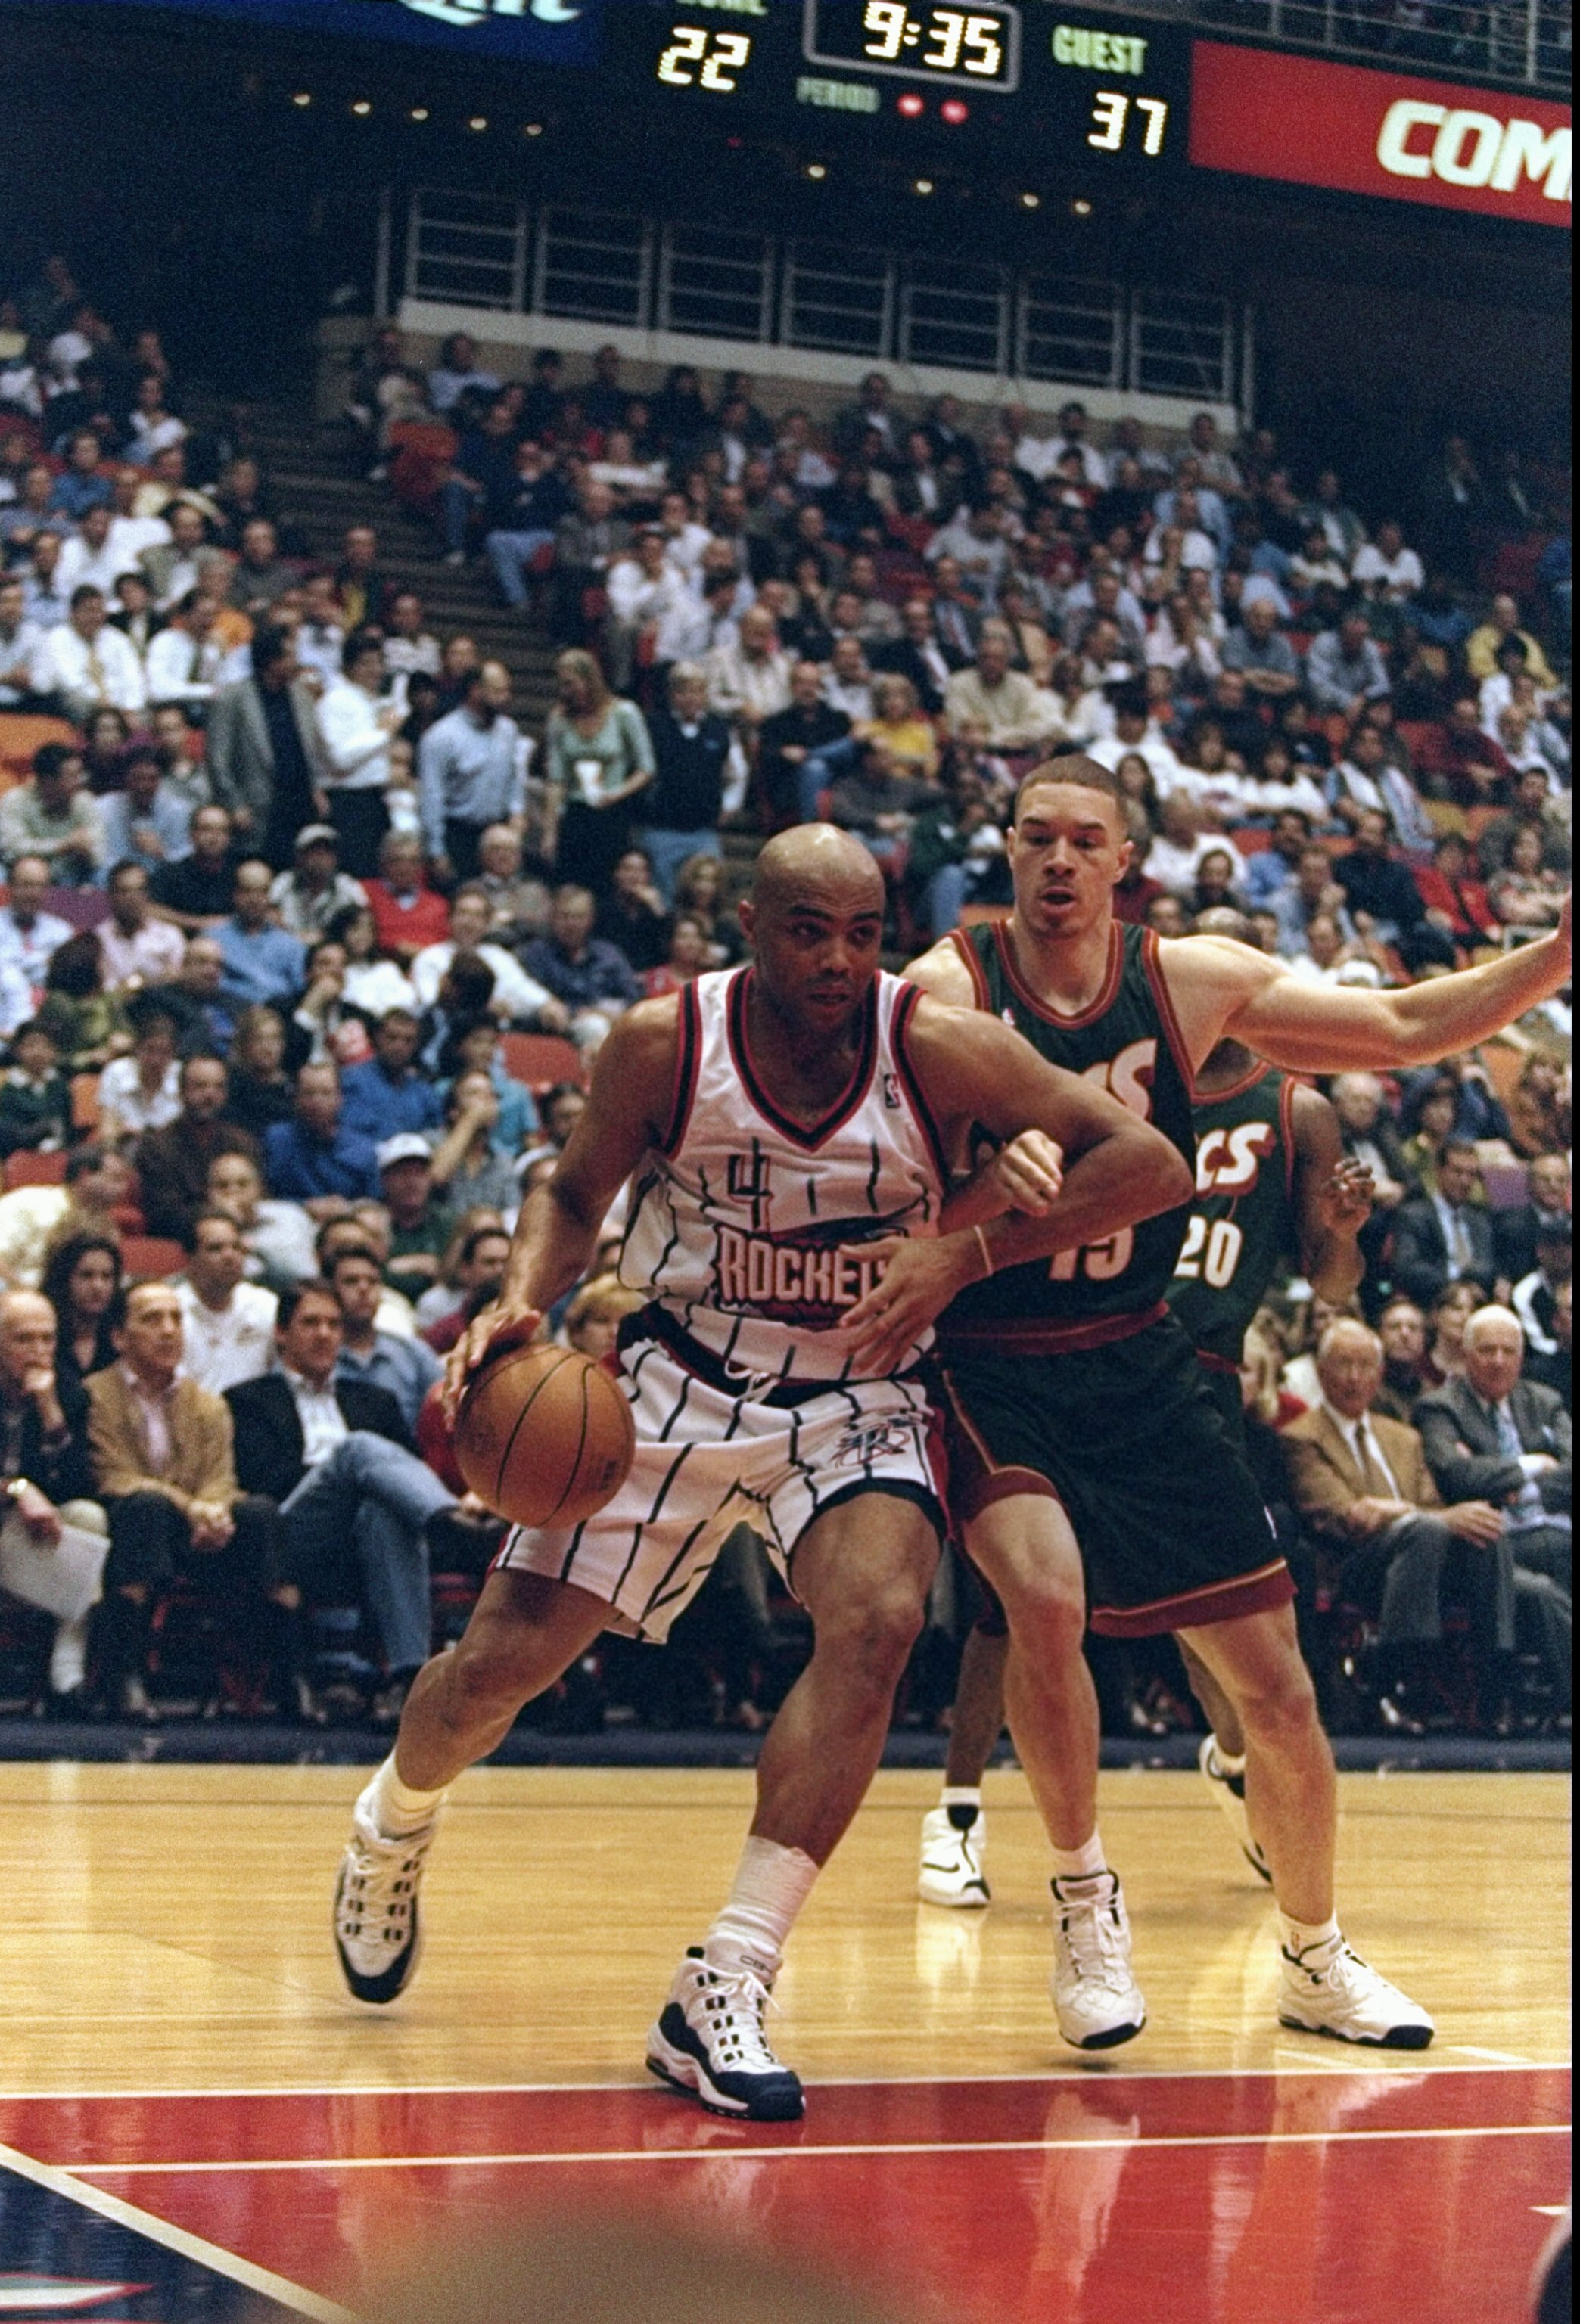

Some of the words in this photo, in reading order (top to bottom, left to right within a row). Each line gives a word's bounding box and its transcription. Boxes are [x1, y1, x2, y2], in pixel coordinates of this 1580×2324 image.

[658, 26, 750, 91] 22
[864, 1, 1000, 74] 9:35
[1052, 25, 1149, 76] GUEST
[1088, 92, 1168, 154] 37
[1376, 98, 1572, 201] COM
[727, 1153, 773, 1231] 4
[718, 1226, 888, 1305] ROCKET
[1173, 1215, 1243, 1288] 20
